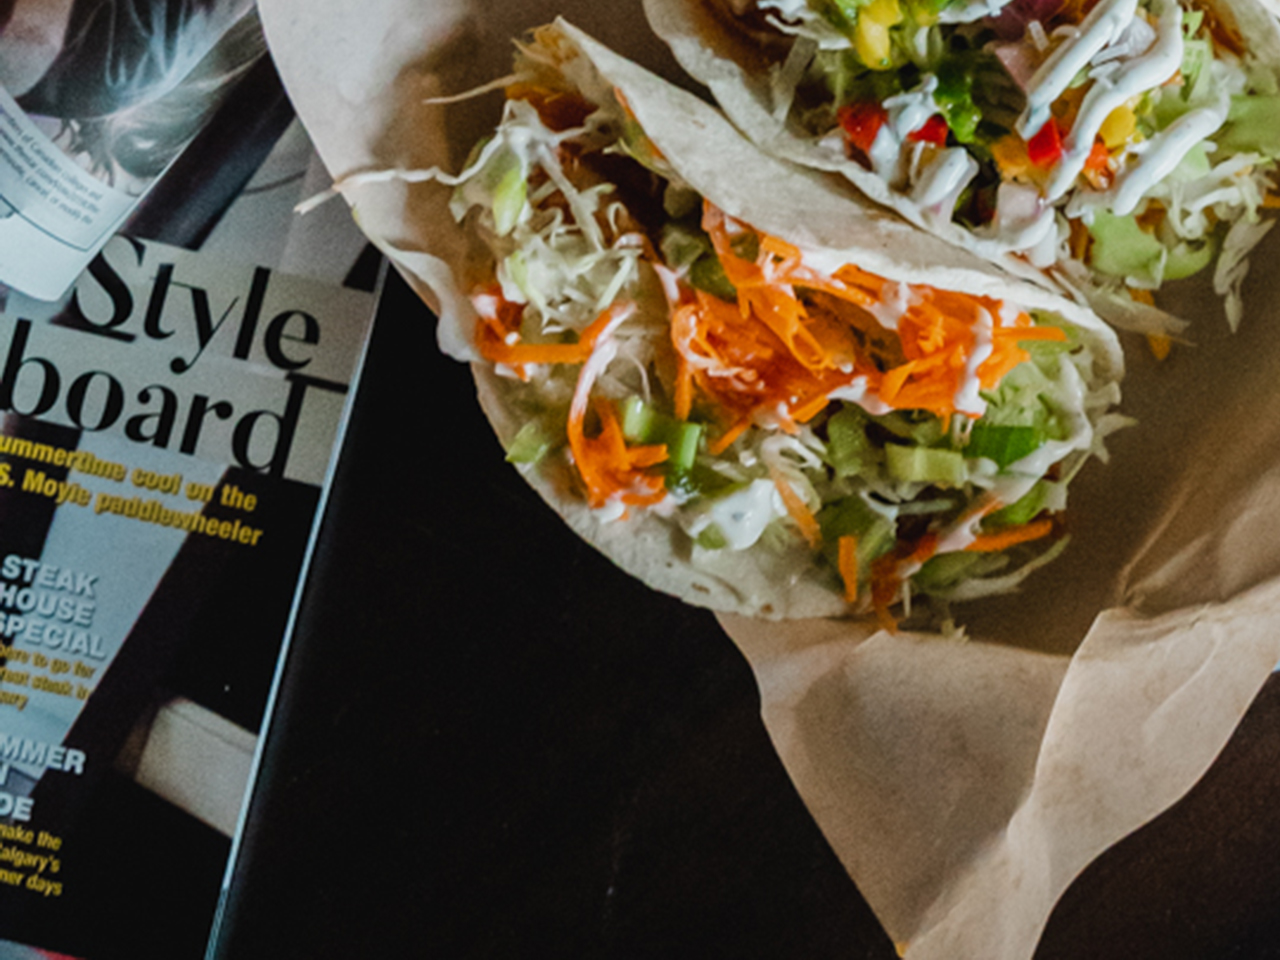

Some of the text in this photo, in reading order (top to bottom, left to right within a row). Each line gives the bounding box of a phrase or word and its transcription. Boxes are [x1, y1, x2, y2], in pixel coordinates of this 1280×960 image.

[73, 232, 321, 375] Style
[0, 318, 307, 479] board
[94, 489, 264, 546] paddlewheeler
[130, 466, 183, 496] cool
[186, 481, 215, 503] on
[220, 483, 258, 512] the
[2, 554, 99, 598] STEAK
